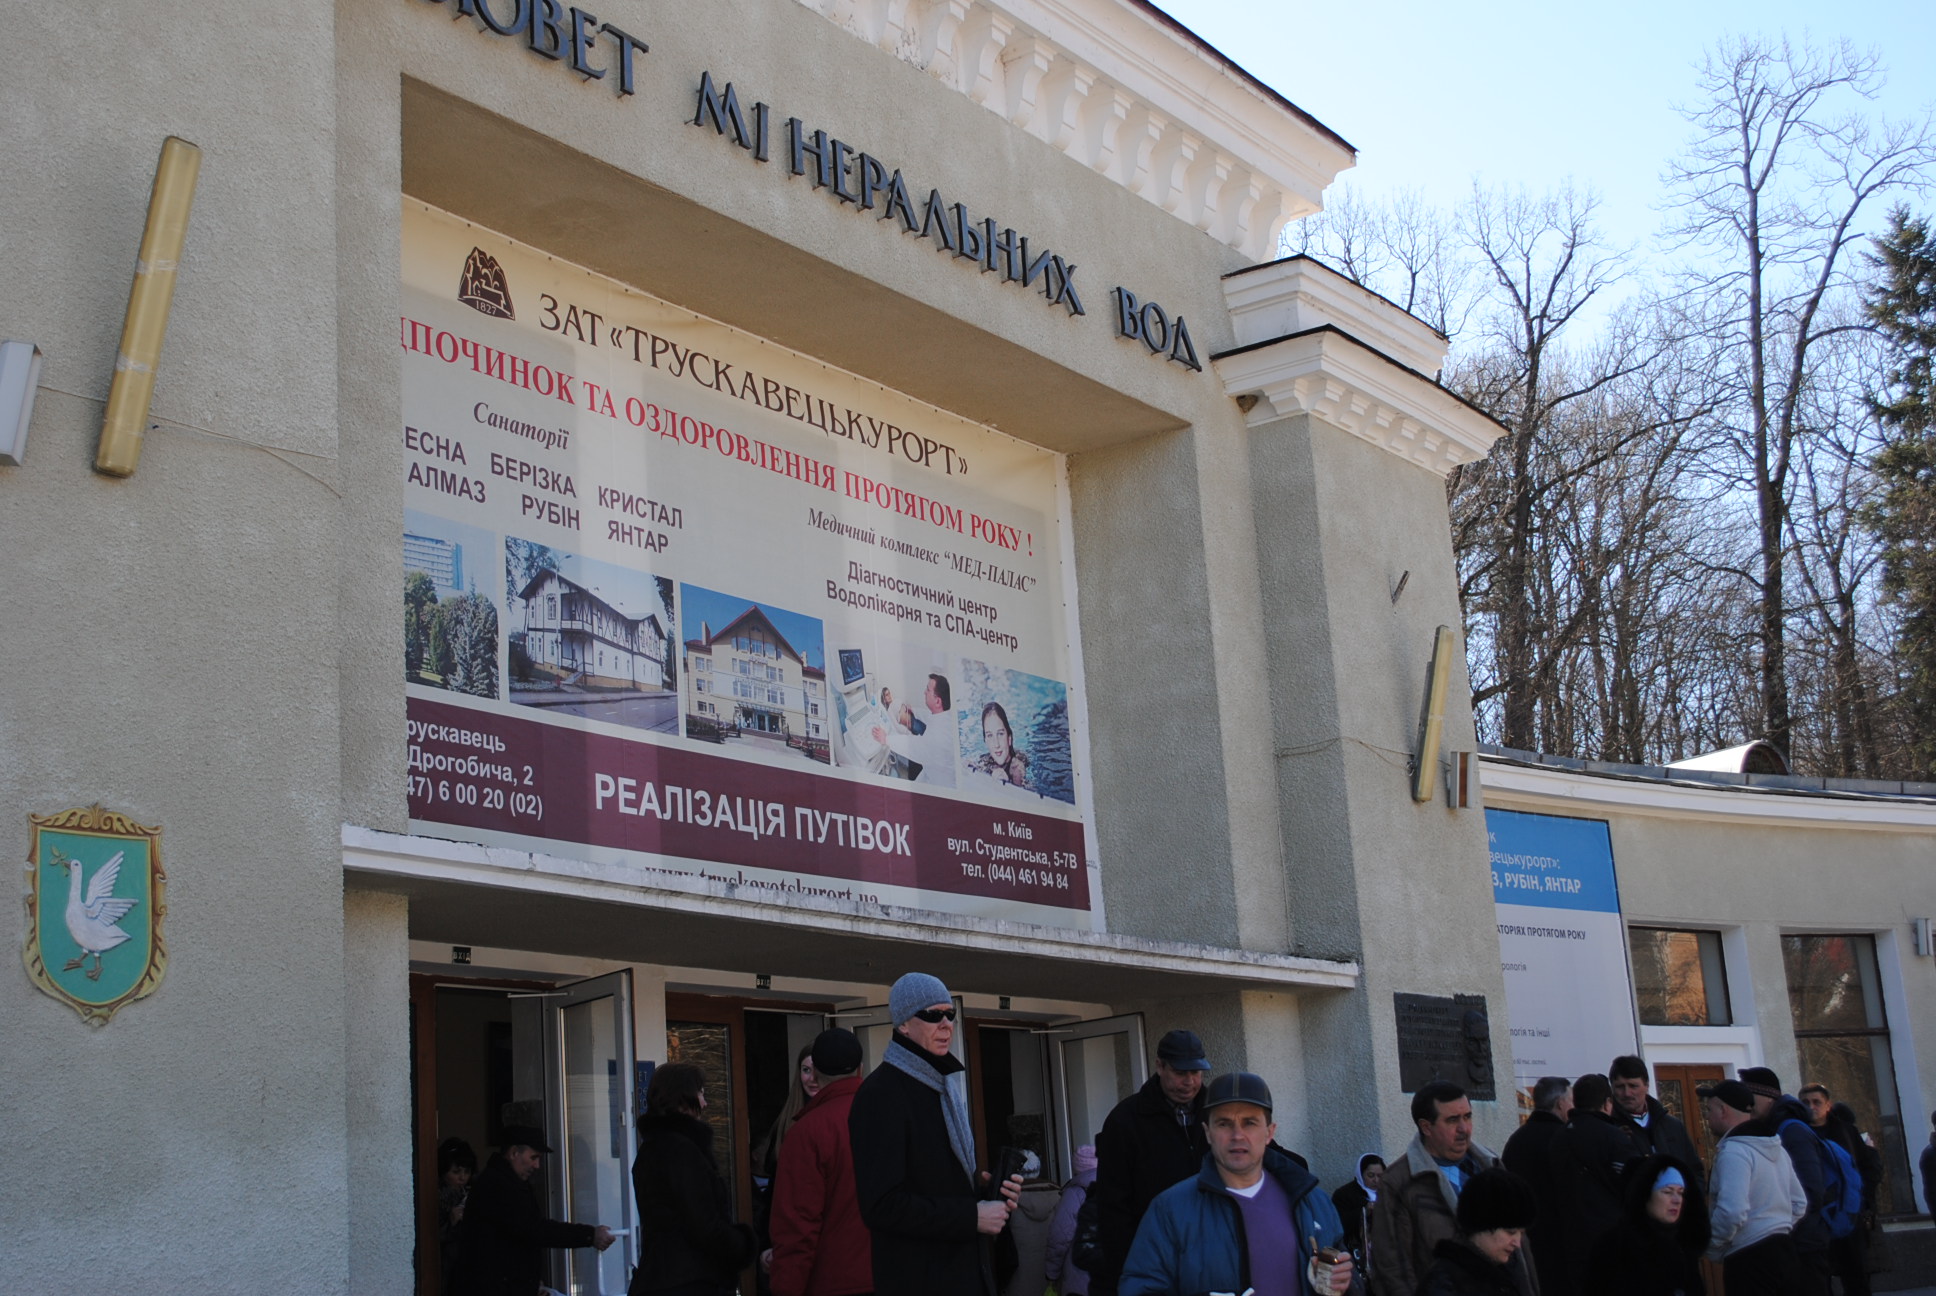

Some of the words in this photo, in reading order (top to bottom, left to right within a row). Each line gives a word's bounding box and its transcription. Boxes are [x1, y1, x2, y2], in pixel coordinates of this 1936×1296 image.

[475, 300, 497, 315] 1827
[1115, 286, 1202, 371] ВОД
[539, 293, 604, 347] ЗАТ
[610, 325, 968, 476] «ТРУСКАВЕЦЬКУРОРТ»
[400, 315, 575, 405] ПОЧИНОК
[583, 380, 618, 419] ТА
[625, 396, 837, 493] ОЗДОРОВЛЕННЯ
[844, 470, 963, 534] ПРОТЯГОМ
[970, 513, 1022, 552] РОКУ
[473, 401, 570, 450] Санаторії
[401, 425, 467, 465] ЕСНА
[490, 452, 577, 498] БЕРІЗКА
[598, 485, 683, 529] КРИСТАЛ
[407, 462, 486, 503] АЛМАЗ
[521, 494, 580, 531] РУБІН
[607, 520, 669, 554] ЯНТАР
[807, 508, 875, 545] Медичний
[880, 535, 940, 564] комплекс
[826, 579, 922, 623] Водолікарня
[926, 612, 941, 629] та
[945, 613, 1018, 652] СПА-центр
[848, 560, 954, 609] Діагностичний
[958, 597, 998, 623] центр
[406, 719, 506, 754] рускавець
[407, 744, 517, 787] Дрогобича,
[523, 765, 534, 786] 2
[406, 775, 433, 804] 47)
[439, 780, 450, 801] 6
[455, 783, 477, 805] 00
[483, 787, 504, 809] 20
[510, 791, 543, 821] (02)
[595, 772, 786, 840] РЕАЛІЗАЦІЯ
[794, 806, 911, 857] ПУТІВОК
[947, 837, 973, 855] вул.
[975, 838, 1051, 868] Студентська,
[993, 822, 1005, 836] м.
[1008, 821, 1033, 840] Київ
[961, 862, 985, 878] тел.
[988, 863, 1016, 886] (044)
[1018, 868, 1038, 885] 461
[1040, 870, 1054, 887] 94
[1056, 873, 1069, 889] 84
[1505, 872, 1543, 892] РУБІН,
[1545, 876, 1581, 893] ЯНТАР
[1527, 926, 1566, 938] ПРОТЯГОМ
[1567, 930, 1586, 940] РОКУ
